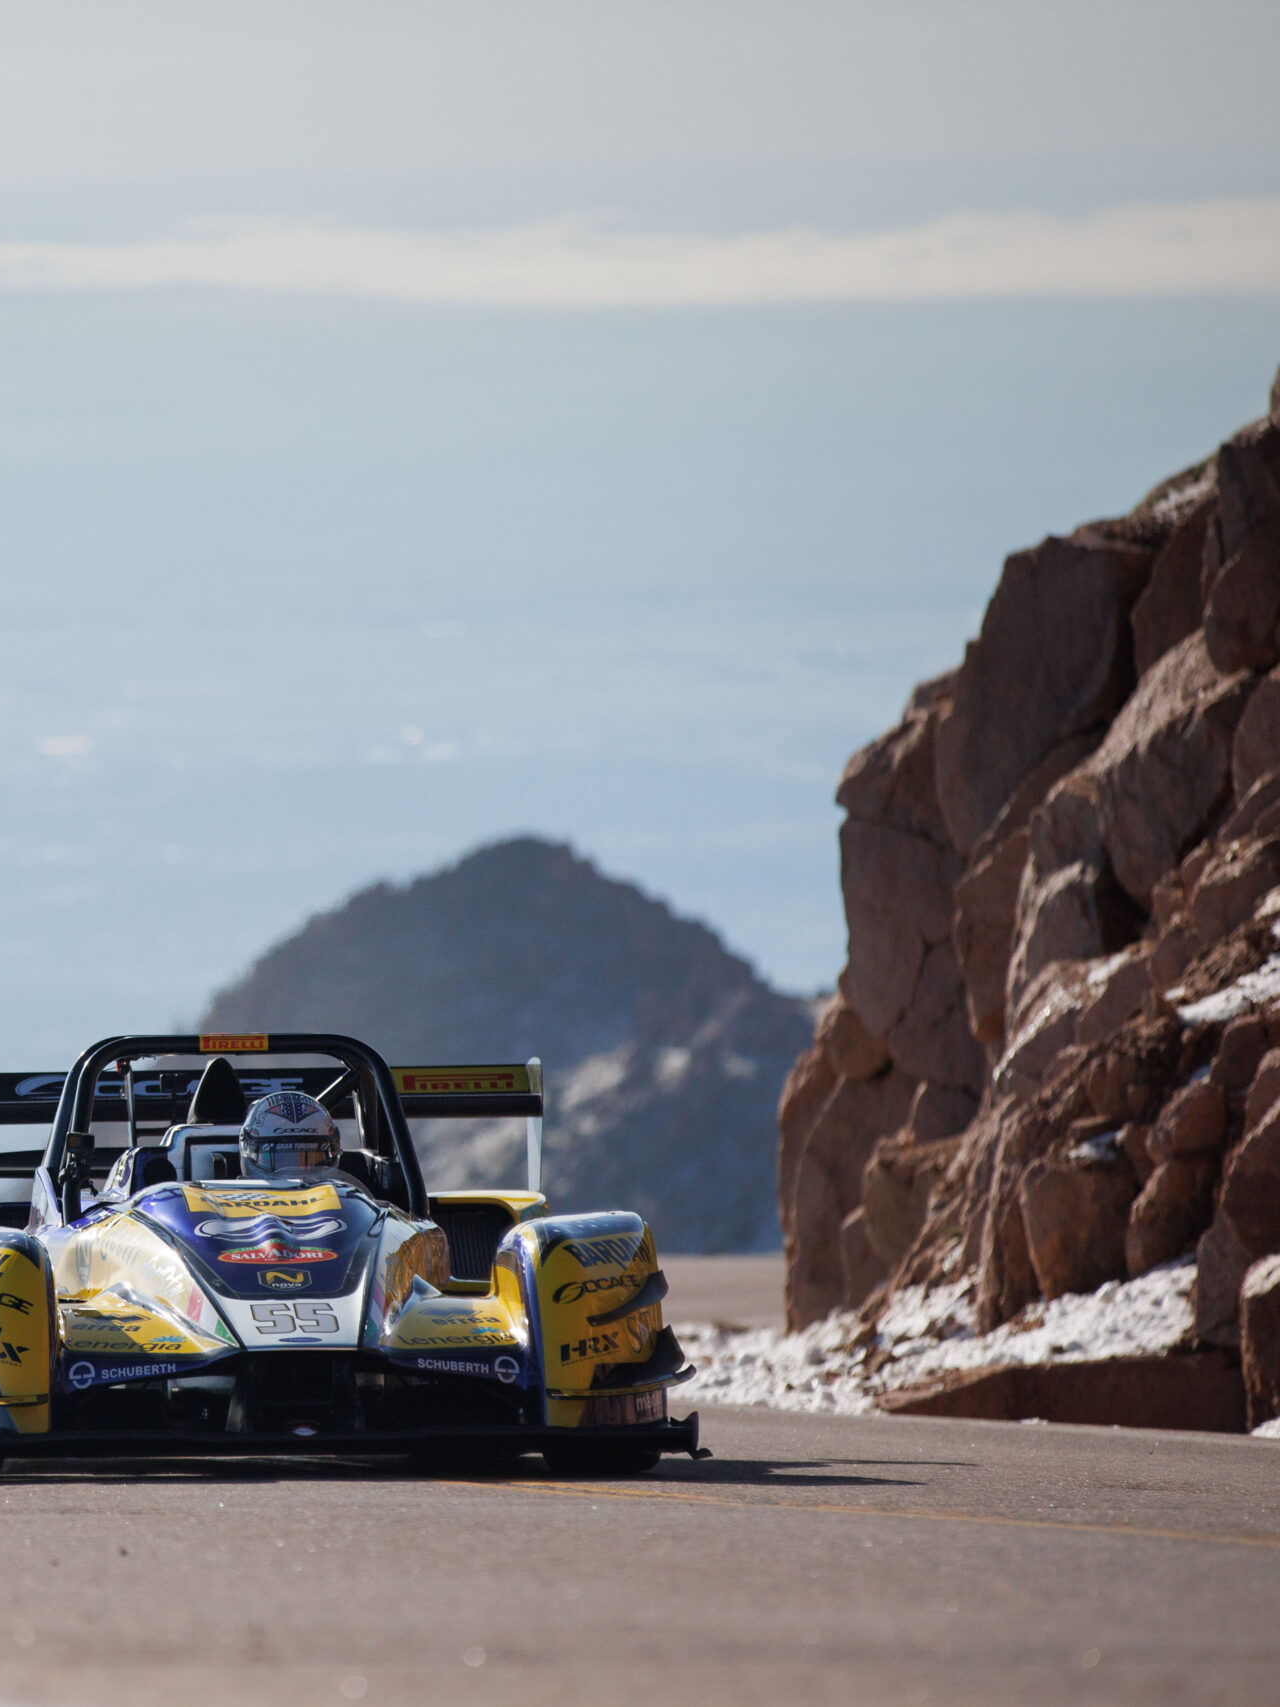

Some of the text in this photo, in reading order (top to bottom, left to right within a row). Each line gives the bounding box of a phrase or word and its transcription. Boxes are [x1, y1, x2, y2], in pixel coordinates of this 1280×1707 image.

[203, 1036, 264, 1049] PIRELLI
[402, 1073, 514, 1091] PIRELLI
[231, 1248, 325, 1261] SALVADORI
[250, 1302, 340, 1335] 55
[560, 1331, 620, 1362] HRX
[101, 1363, 176, 1379] SCHUBERTH
[417, 1358, 489, 1374] SCHUBERTH
